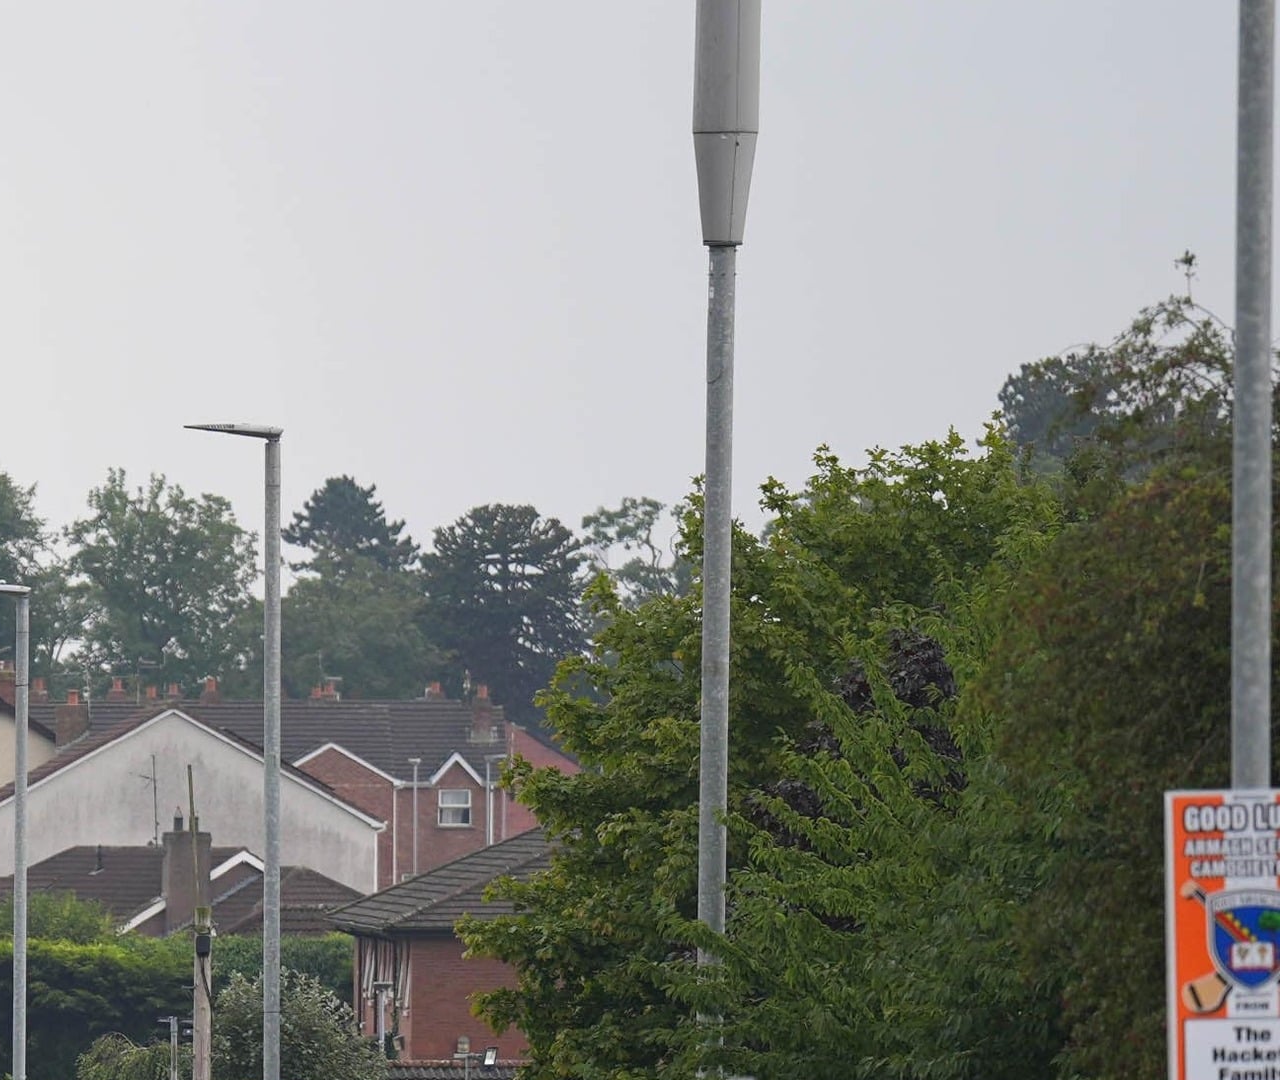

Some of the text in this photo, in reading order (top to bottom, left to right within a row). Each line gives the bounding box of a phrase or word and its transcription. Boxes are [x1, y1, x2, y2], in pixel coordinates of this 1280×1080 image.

[1183, 805, 1248, 832] GOOD
[1184, 838, 1253, 857] ARMAGH
[1234, 1026, 1271, 1042] The
[1212, 1046, 1280, 1062] Hacke
